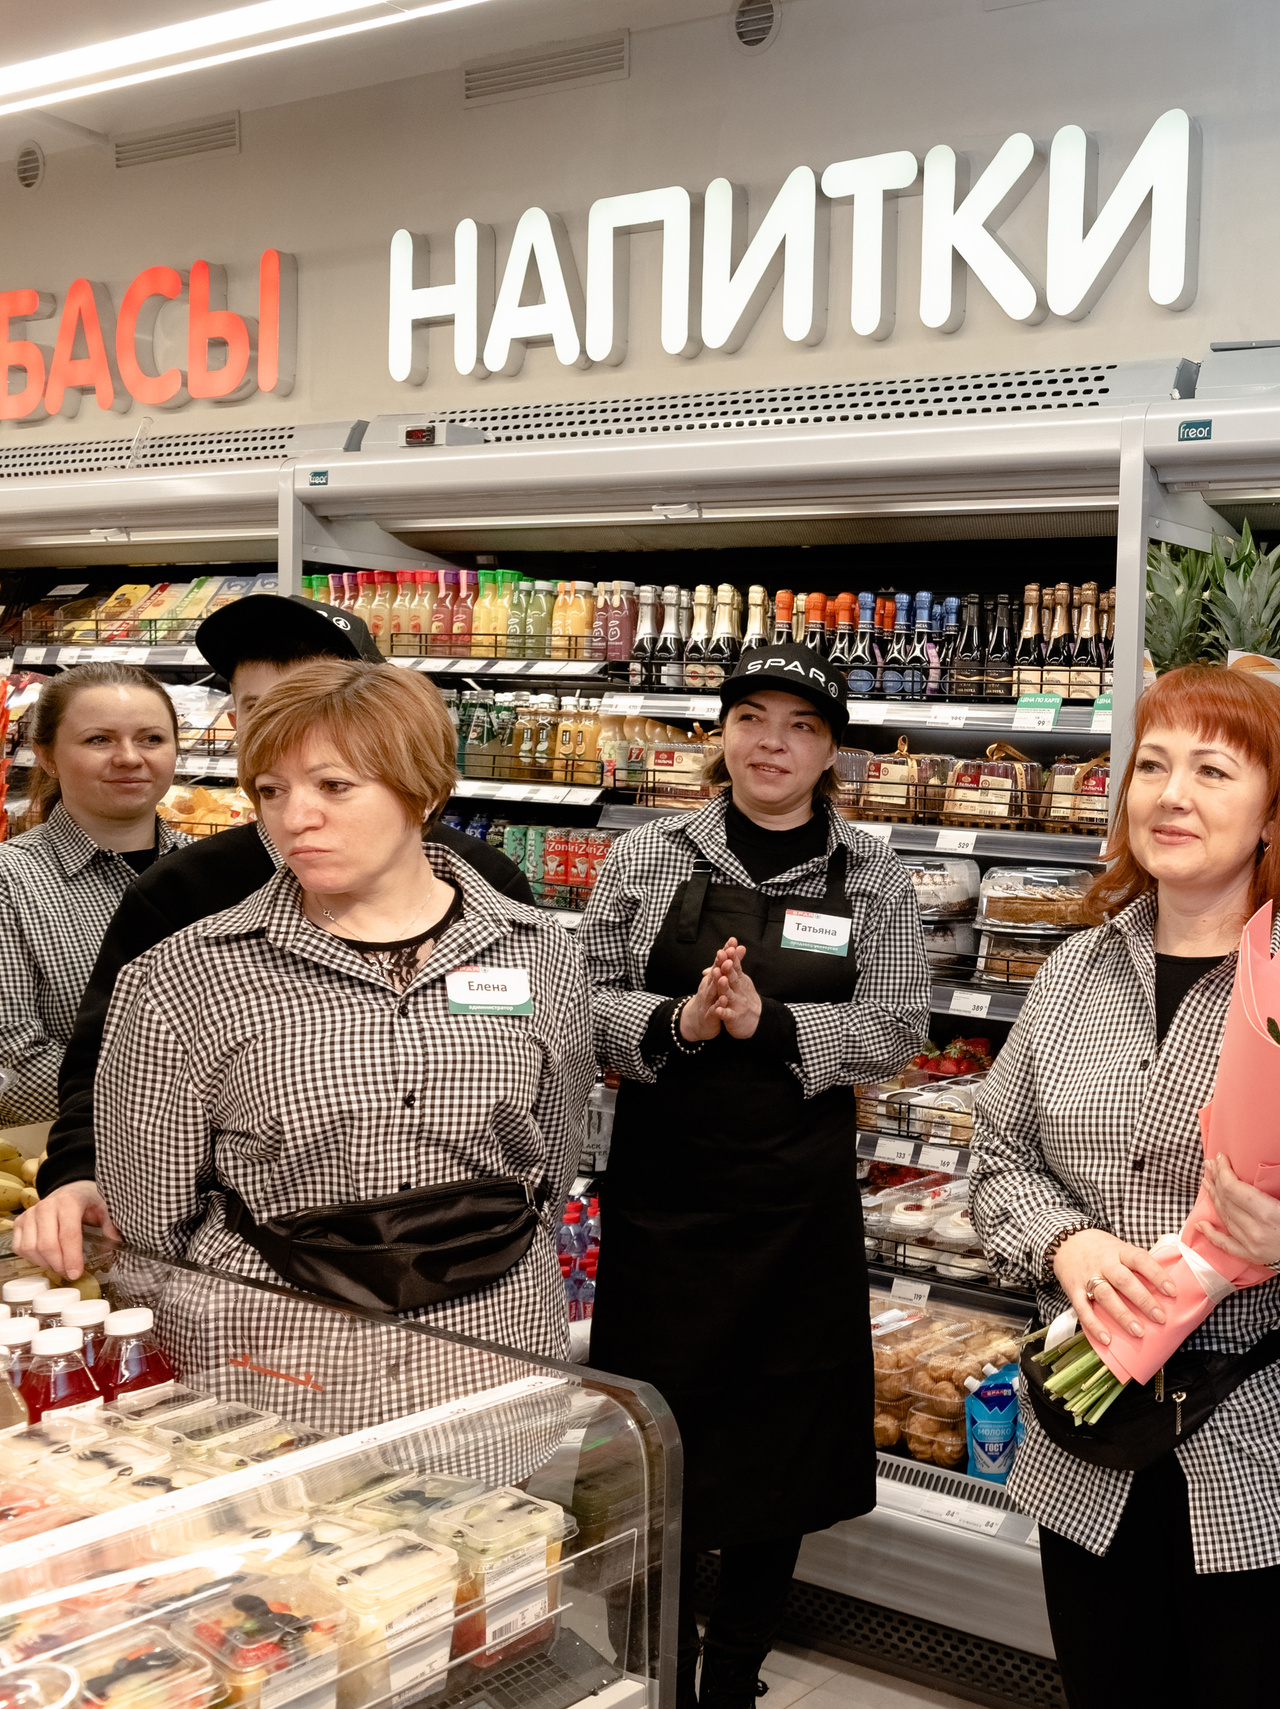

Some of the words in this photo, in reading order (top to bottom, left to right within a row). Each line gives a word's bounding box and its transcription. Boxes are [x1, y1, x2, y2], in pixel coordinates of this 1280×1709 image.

[388, 108, 1190, 383] НАПИТКИ
[0, 248, 280, 420] БАСЫ
[1180, 423, 1210, 438] freor
[746, 658, 826, 687] SPAR
[795, 922, 837, 936] Татьяна
[468, 981, 507, 992] Елена
[978, 1428, 1011, 1436] МОЛОКО
[985, 1443, 1004, 1452] ГОСТ
